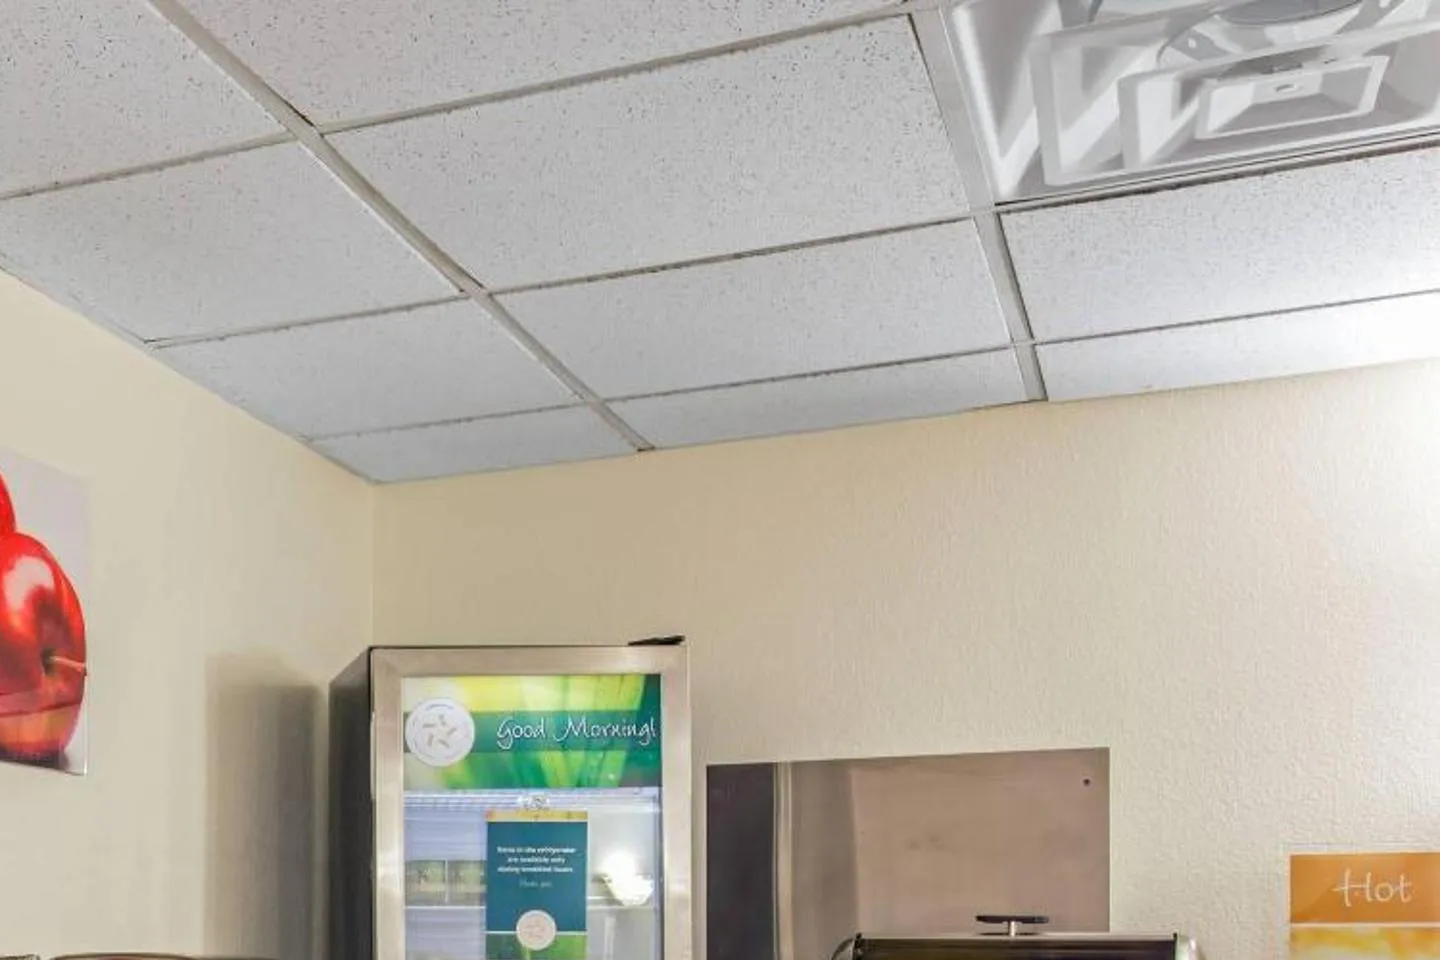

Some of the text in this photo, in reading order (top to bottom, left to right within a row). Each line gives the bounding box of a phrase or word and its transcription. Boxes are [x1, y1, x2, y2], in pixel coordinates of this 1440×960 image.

[496, 714, 657, 750] Good Morning!
[1331, 868, 1413, 907] Hot
